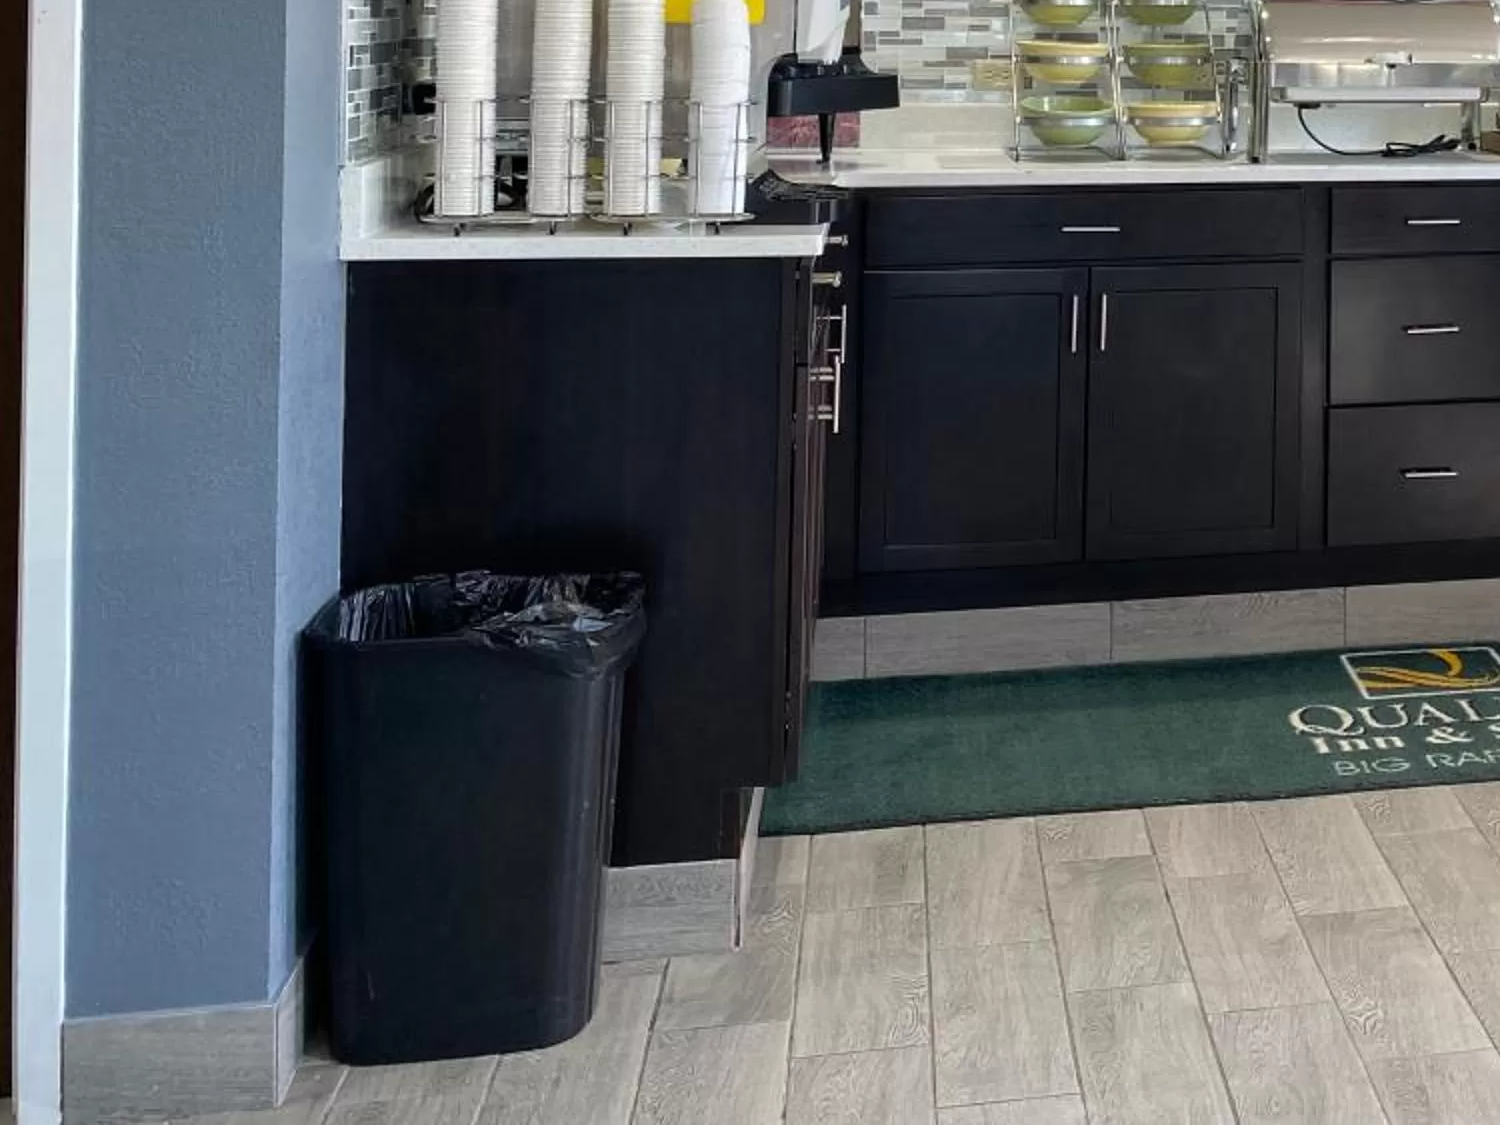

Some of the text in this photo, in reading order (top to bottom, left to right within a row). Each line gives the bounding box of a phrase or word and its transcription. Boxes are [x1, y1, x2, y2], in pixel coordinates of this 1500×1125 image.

[1309, 736, 1405, 754] Inn
[1425, 726, 1474, 744] &
[1332, 756, 1411, 776] BIG
